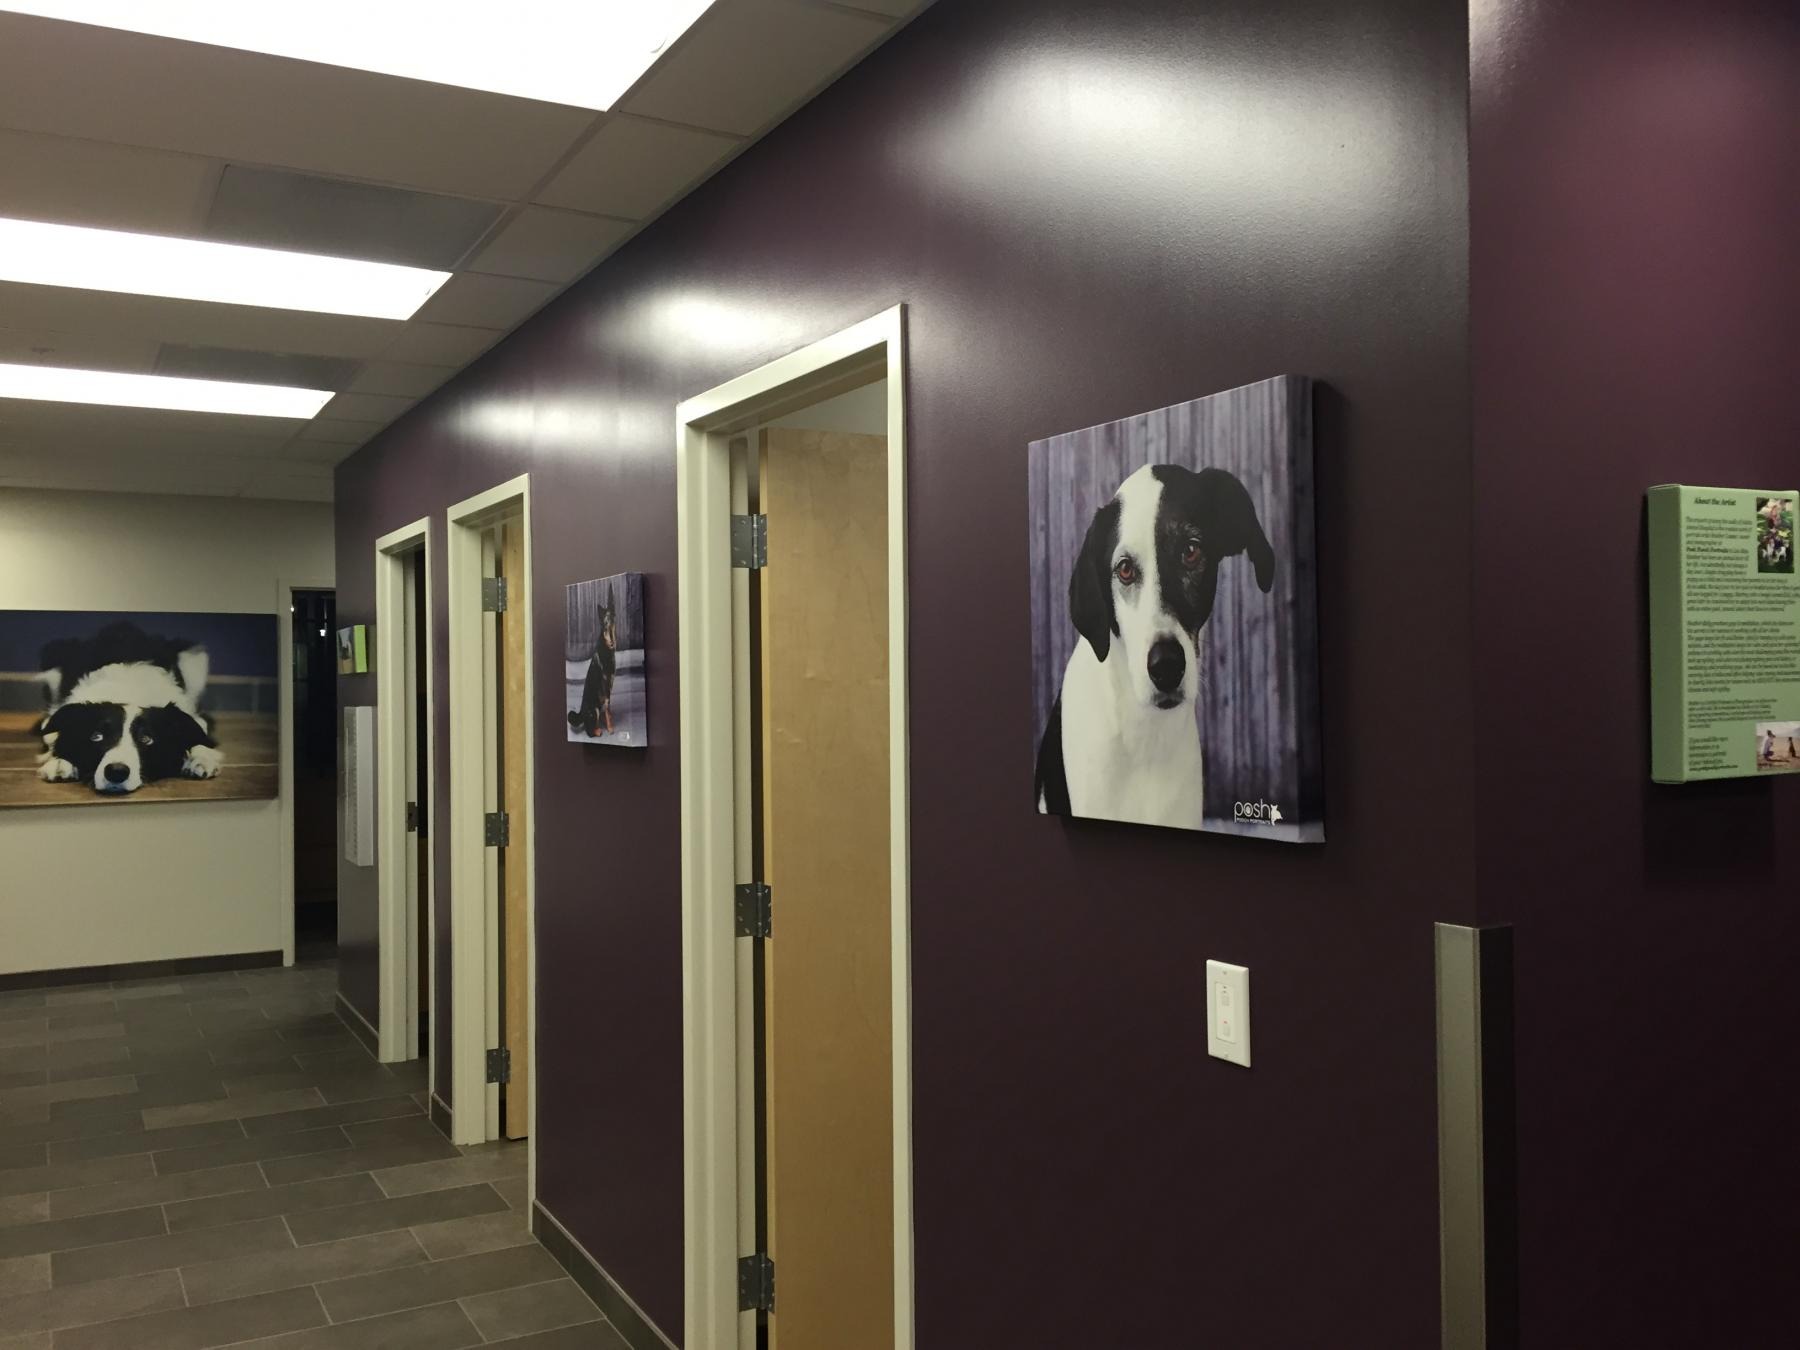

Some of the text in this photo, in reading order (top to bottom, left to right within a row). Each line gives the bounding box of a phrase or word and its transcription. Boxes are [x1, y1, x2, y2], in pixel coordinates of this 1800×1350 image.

[1711, 497, 1720, 505] the
[1721, 498, 1736, 506] Artist
[1234, 798, 1270, 823] posh
